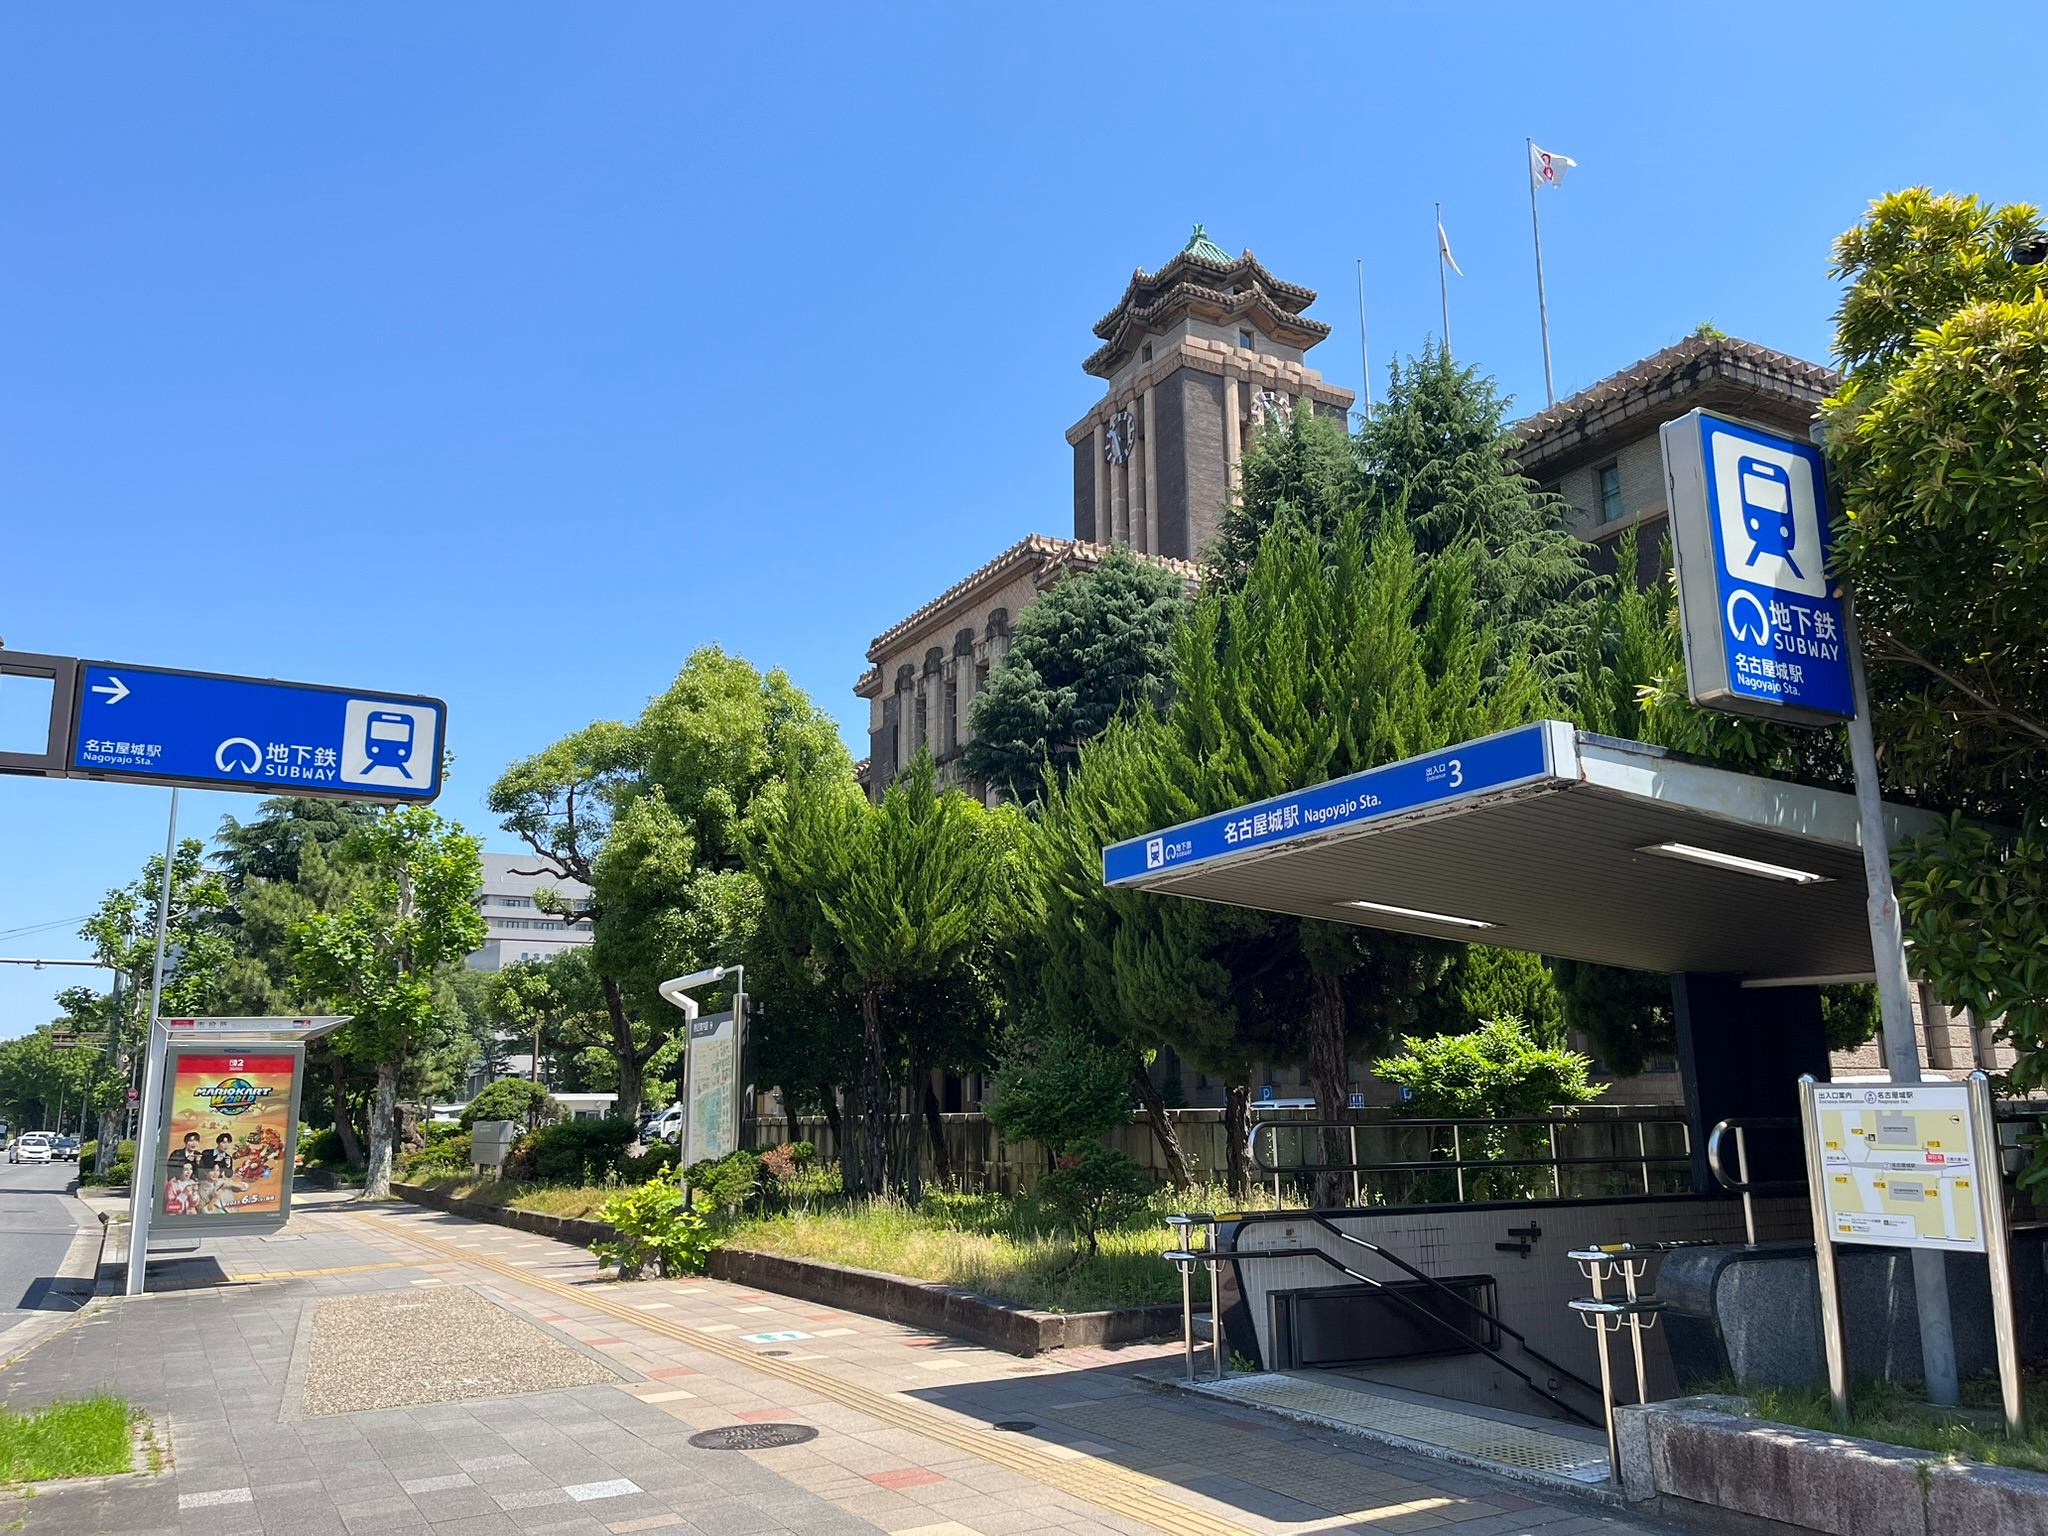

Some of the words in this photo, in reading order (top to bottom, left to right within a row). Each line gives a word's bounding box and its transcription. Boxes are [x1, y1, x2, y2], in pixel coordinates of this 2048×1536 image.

[1768, 600, 1837, 642] 地下鉄
[1773, 632, 1839, 662] SUBWAY
[1735, 652, 1805, 684] 名古屋城駅
[1737, 672, 1782, 694] Nagoyajo
[1783, 682, 1801, 697] Sta.
[83, 752, 132, 765] Nagoyajo
[135, 757, 154, 766] Sta.
[85, 739, 162, 757] 名古屋城駅
[265, 742, 337, 768] 地下鉄
[265, 764, 336, 780] SUBWAY
[1425, 763, 1446, 776] 出入口
[1448, 759, 1463, 788] 3
[1304, 799, 1357, 824] Nagoyajo
[1359, 794, 1382, 809] Sta.
[1224, 804, 1300, 844] 名古屋城駅
[193, 1087, 236, 1096] MARIO
[235, 1087, 273, 1096] KART
[211, 1095, 256, 1104] WORLD
